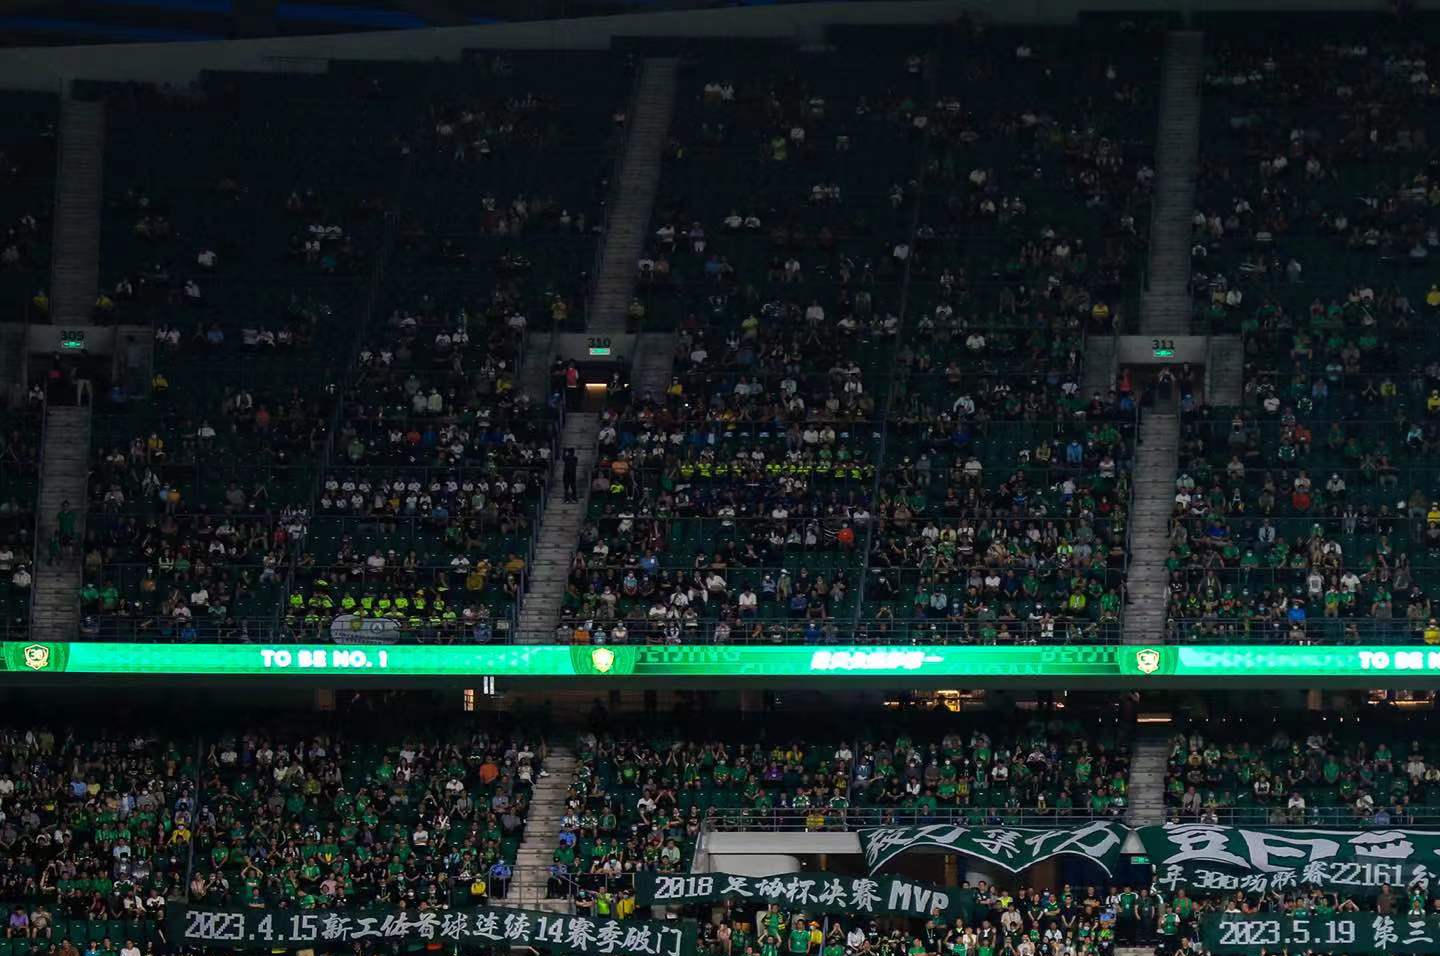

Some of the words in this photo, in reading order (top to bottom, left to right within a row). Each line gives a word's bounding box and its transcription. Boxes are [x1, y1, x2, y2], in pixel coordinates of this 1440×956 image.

[1152, 339, 1175, 350] 311
[261, 649, 291, 667] TO
[298, 649, 326, 667] BE
[333, 649, 373, 667] NO.
[379, 649, 389, 667] 1
[1358, 651, 1384, 669] TO
[1394, 651, 1424, 669] BE
[656, 875, 713, 900] 2018
[889, 880, 949, 912] MVP
[1219, 920, 1357, 945] 2023.5.19
